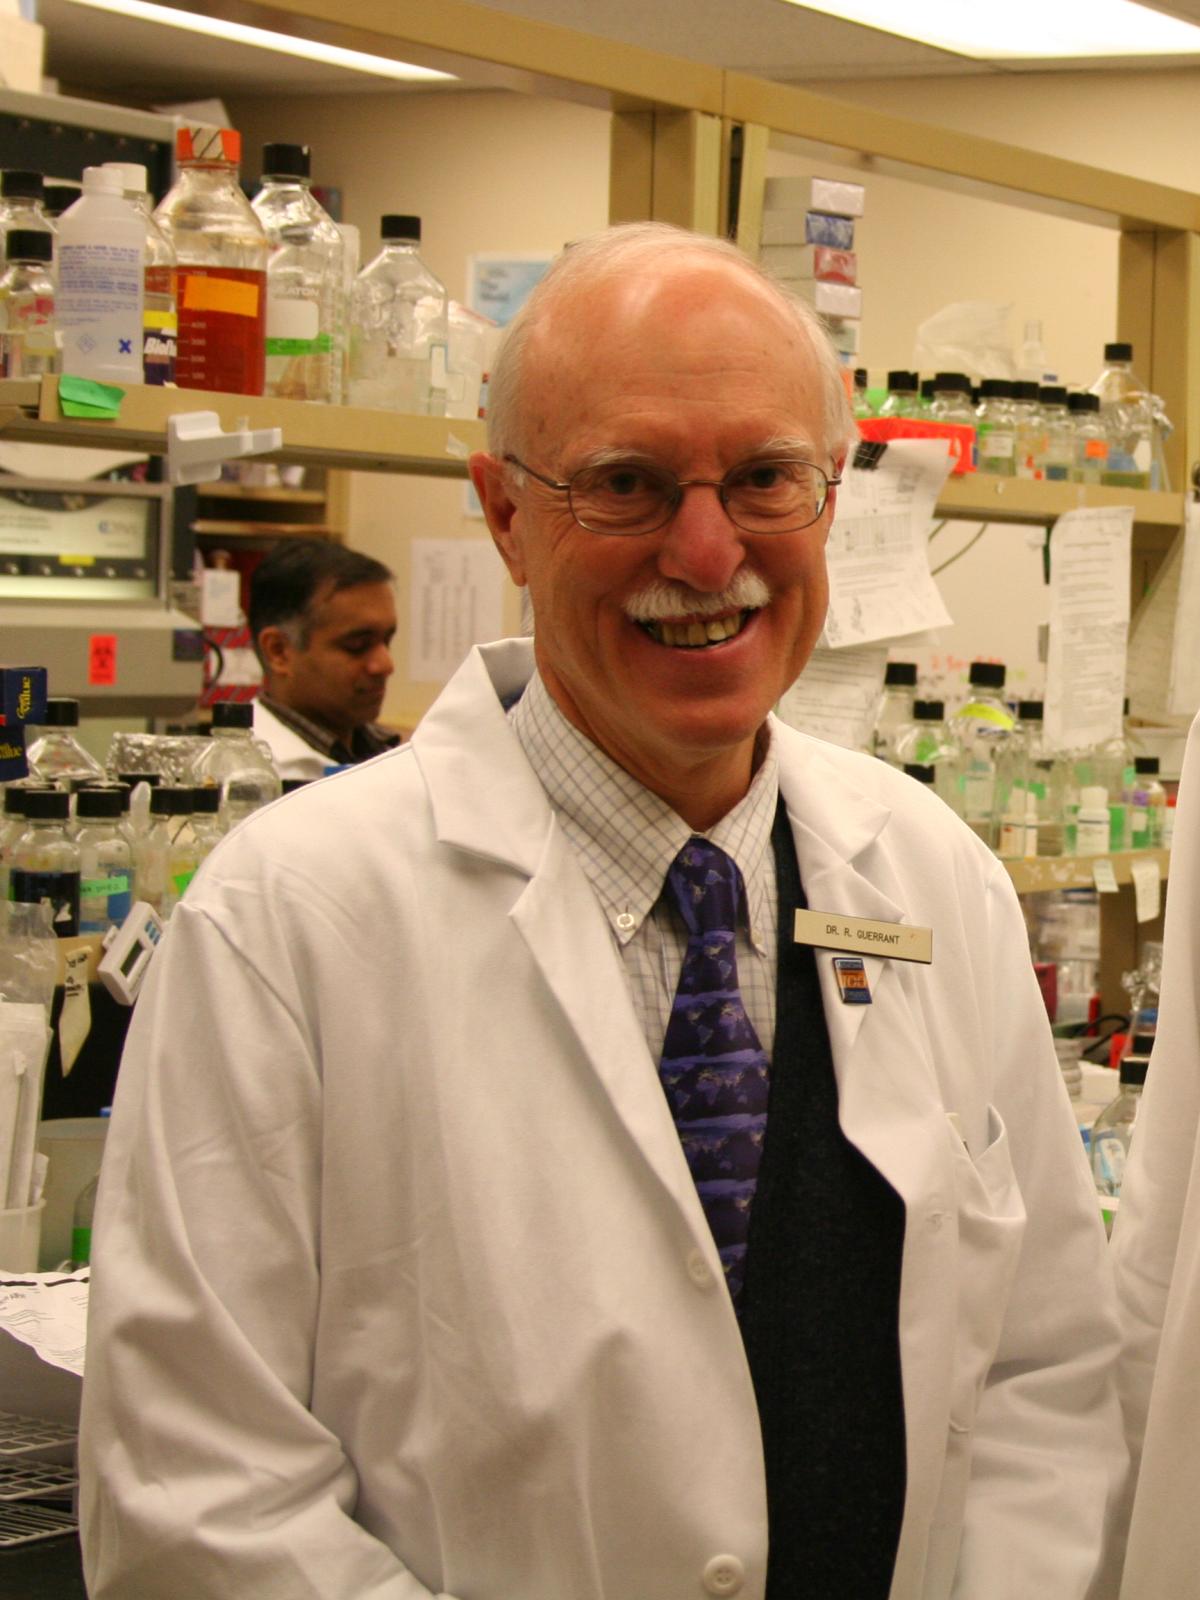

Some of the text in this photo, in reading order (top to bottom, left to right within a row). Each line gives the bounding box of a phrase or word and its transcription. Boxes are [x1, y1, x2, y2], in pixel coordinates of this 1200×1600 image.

[825, 924, 900, 945] DR. R. GUERRANT
